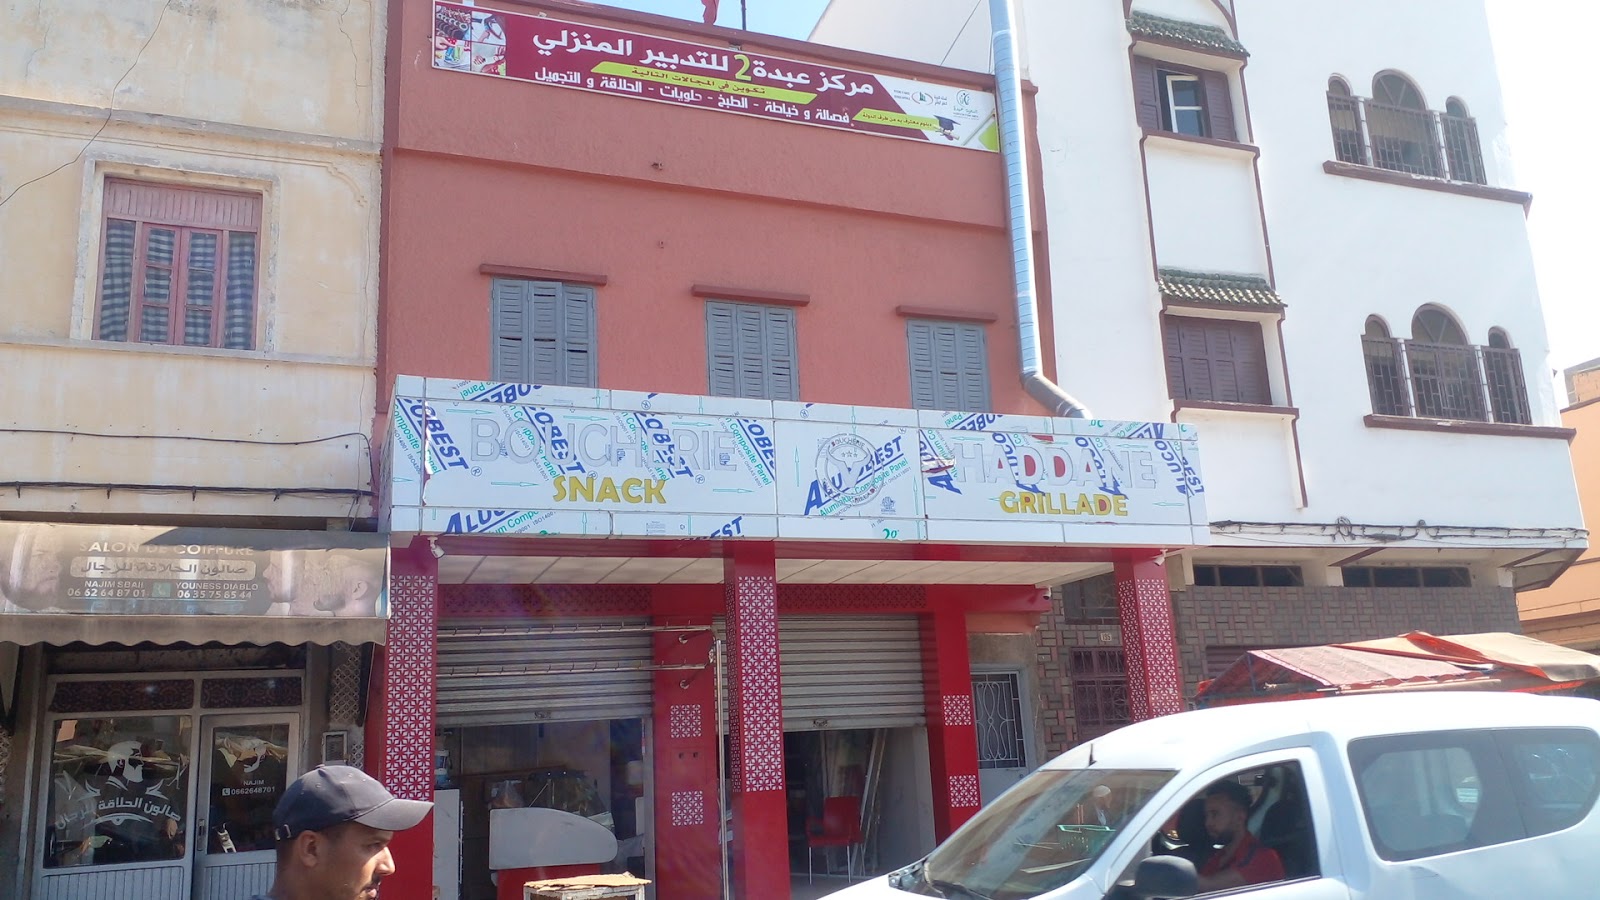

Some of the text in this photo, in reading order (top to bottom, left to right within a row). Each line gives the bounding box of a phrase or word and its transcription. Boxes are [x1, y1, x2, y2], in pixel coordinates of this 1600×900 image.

[532, 29, 633, 57] المنزلي
[639, 48, 729, 71] للتدبير
[734, 53, 752, 81] 2
[535, 66, 580, 84] التجميل
[587, 77, 594, 88] و
[631, 67, 766, 94] تكوين في المجالات التالية
[752, 59, 811, 89] عبدة
[600, 76, 642, 93] الحلاقة
[816, 71, 874, 97] مركز
[660, 85, 702, 103] حلويات
[717, 94, 748, 109] الطبخ
[765, 100, 799, 117] خياطة
[804, 109, 811, 120] و
[470, 417, 738, 473] BOUCHERIE
[729, 422, 772, 486] Composite Panel
[553, 475, 667, 504] SNACK
[1000, 490, 1129, 517] GRILLADE
[79, 542, 140, 553] SALON
[174, 545, 255, 556] COIFFURE
[80, 561, 248, 577] صالون الحلاقة للرجال
[84, 580, 116, 588] NAJIM
[175, 582, 259, 591] YOUNESS DIABLO
[67, 588, 146, 598] 06 62 64 87 01
[177, 589, 191, 598] 06
[192, 590, 206, 599] 35
[208, 590, 222, 599] 75
[231, 786, 275, 795] 0662648701
[98, 797, 142, 810] الحلاقة
[143, 800, 181, 821] صالون
